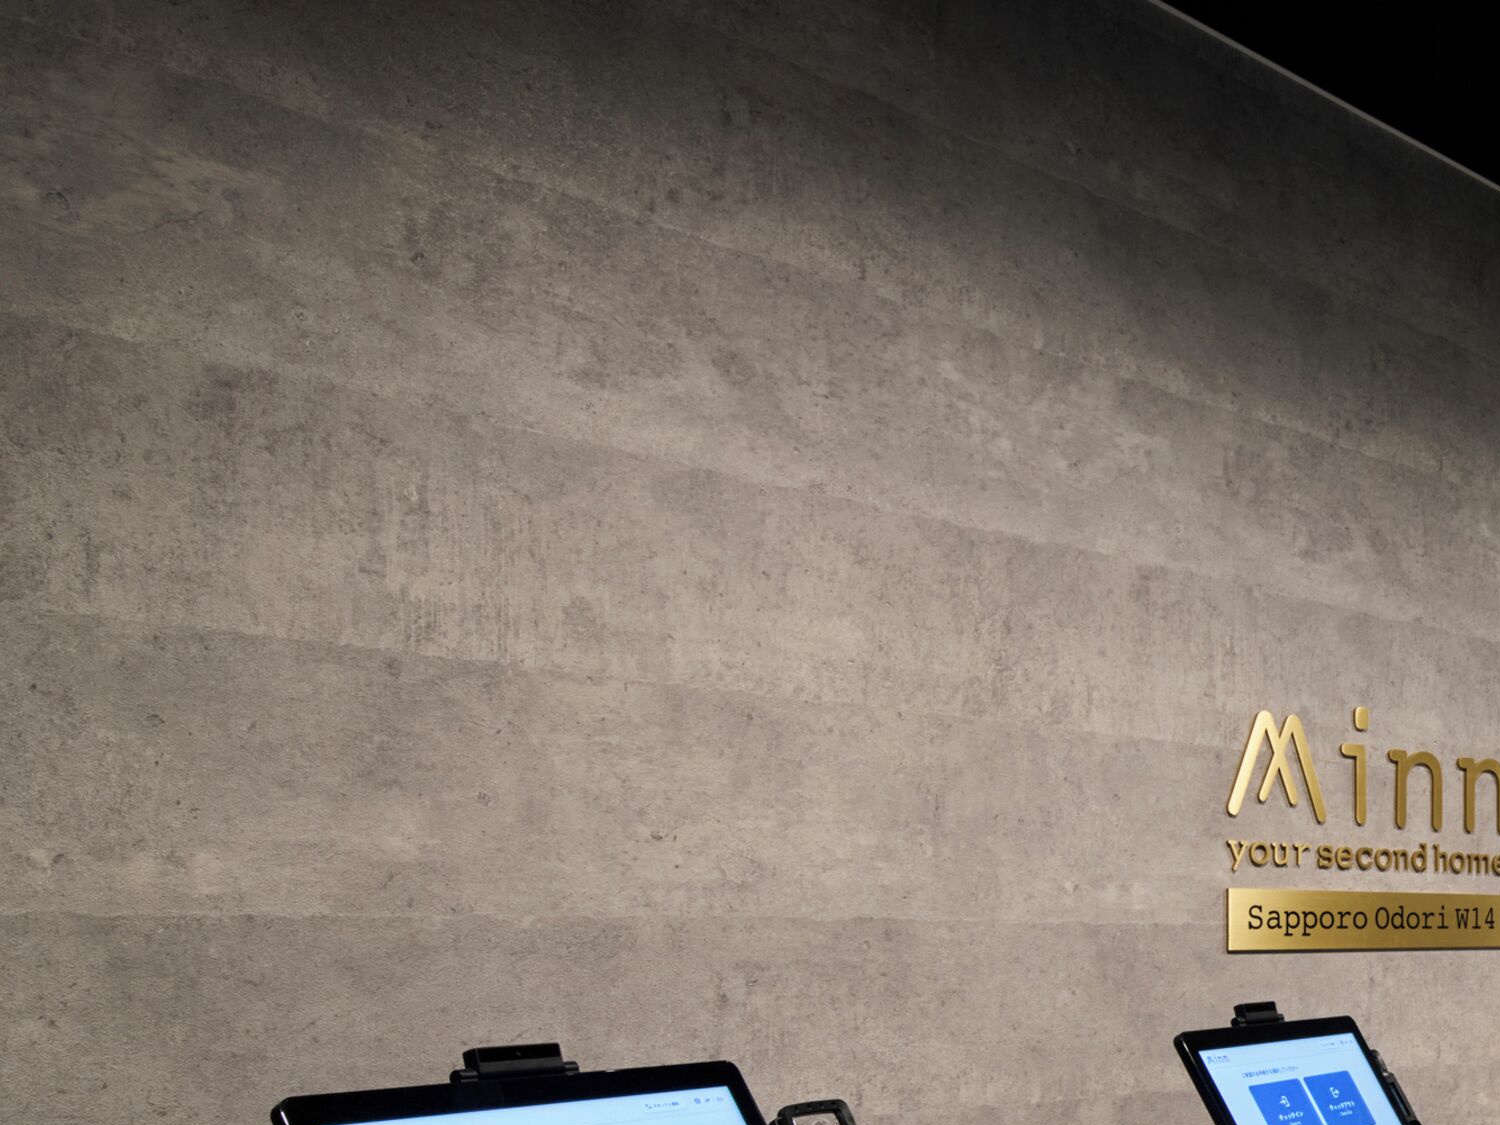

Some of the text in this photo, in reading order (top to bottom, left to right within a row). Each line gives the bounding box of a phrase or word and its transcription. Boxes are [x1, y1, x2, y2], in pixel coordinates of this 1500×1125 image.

[1226, 840, 1311, 873] your
[1317, 843, 1428, 871] second
[1248, 904, 1496, 936] Sapporo Odori W14
